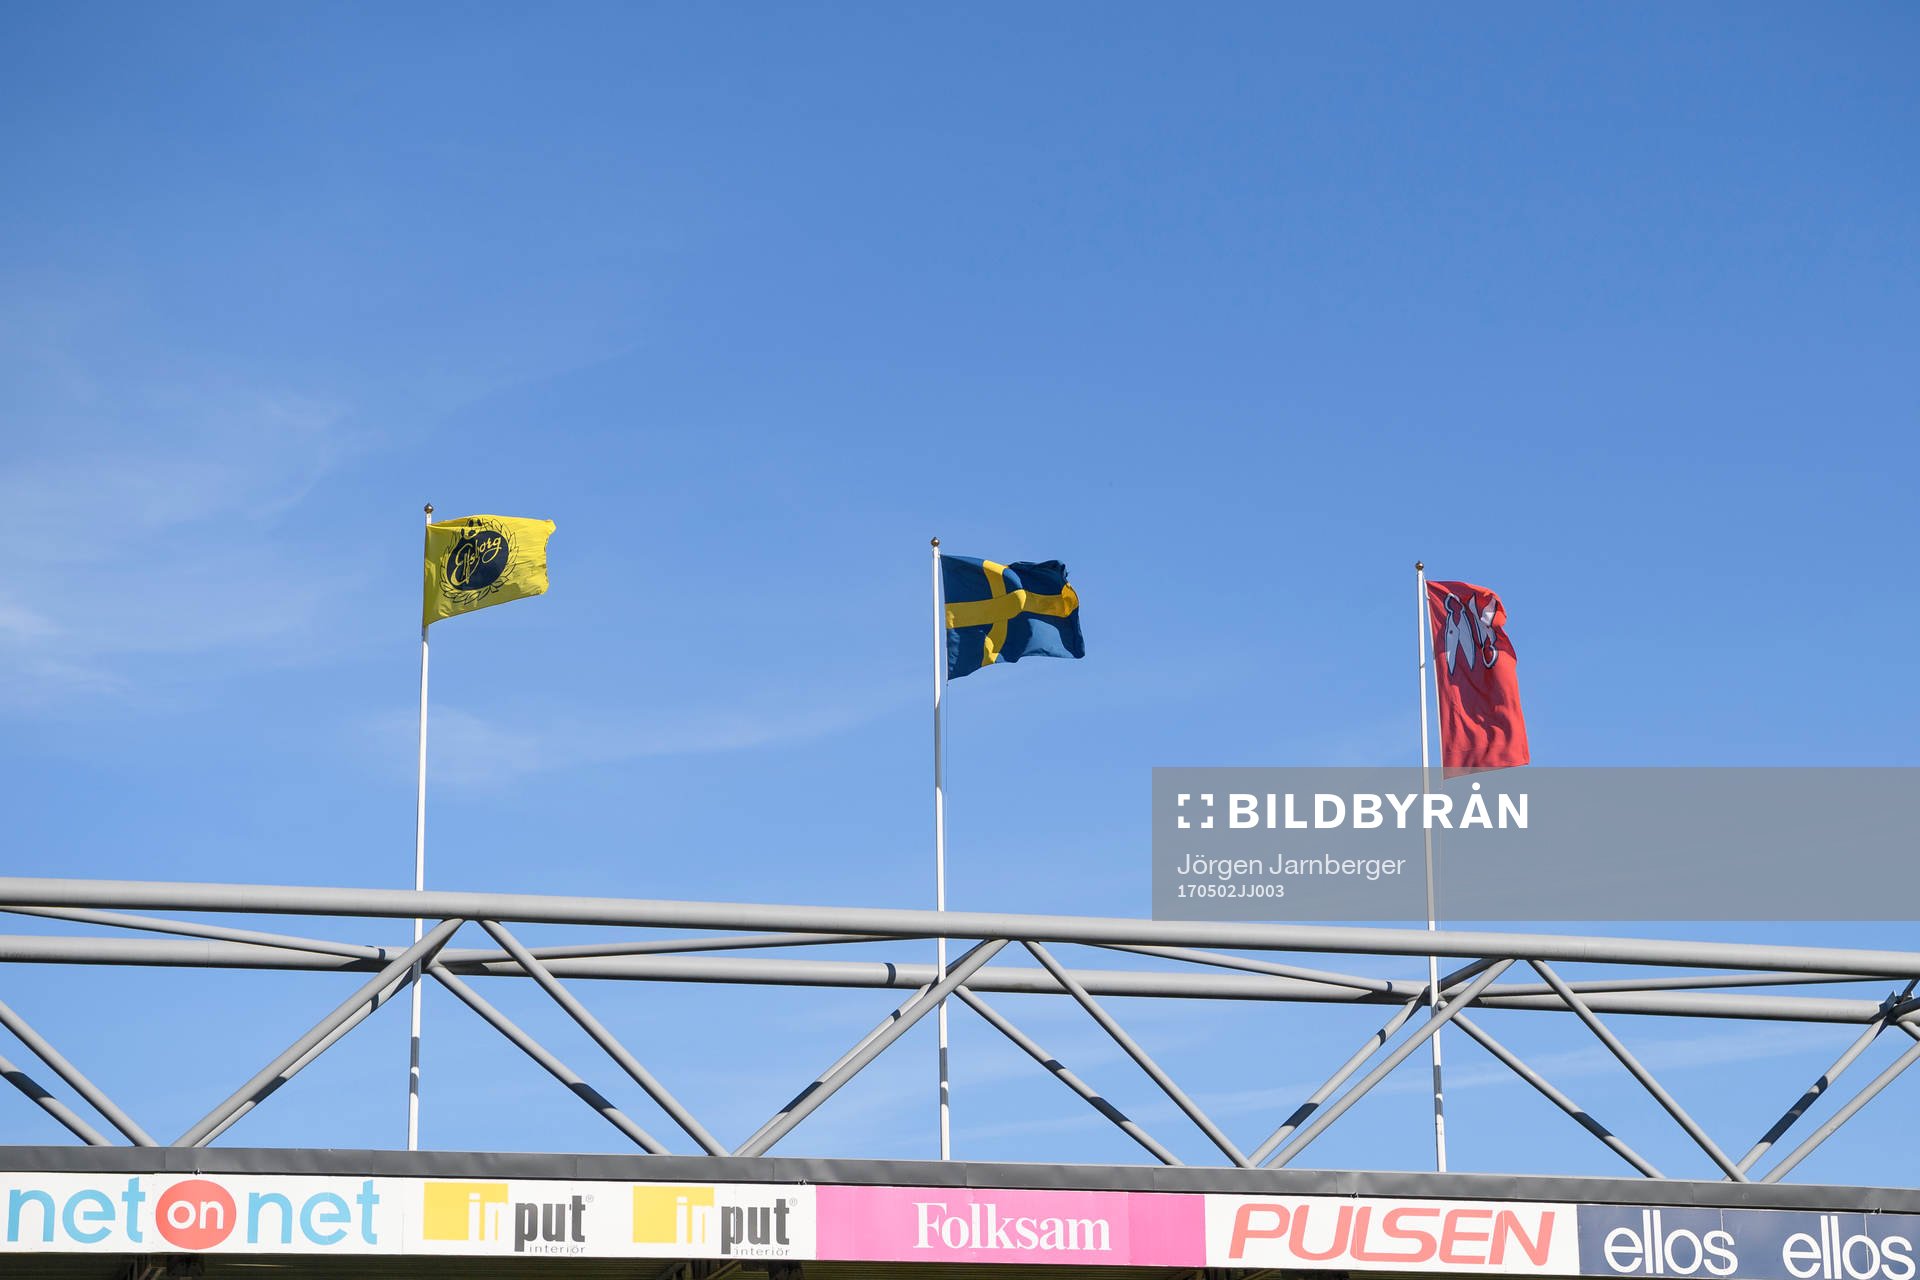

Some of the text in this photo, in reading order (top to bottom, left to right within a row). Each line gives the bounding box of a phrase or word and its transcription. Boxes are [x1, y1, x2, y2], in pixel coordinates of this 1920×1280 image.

[912, 1202, 1112, 1251] Folksam
[1228, 1203, 1556, 1267] PULSEN
[1604, 1209, 1739, 1276] ellos
[1782, 1215, 1917, 1280] ellos
